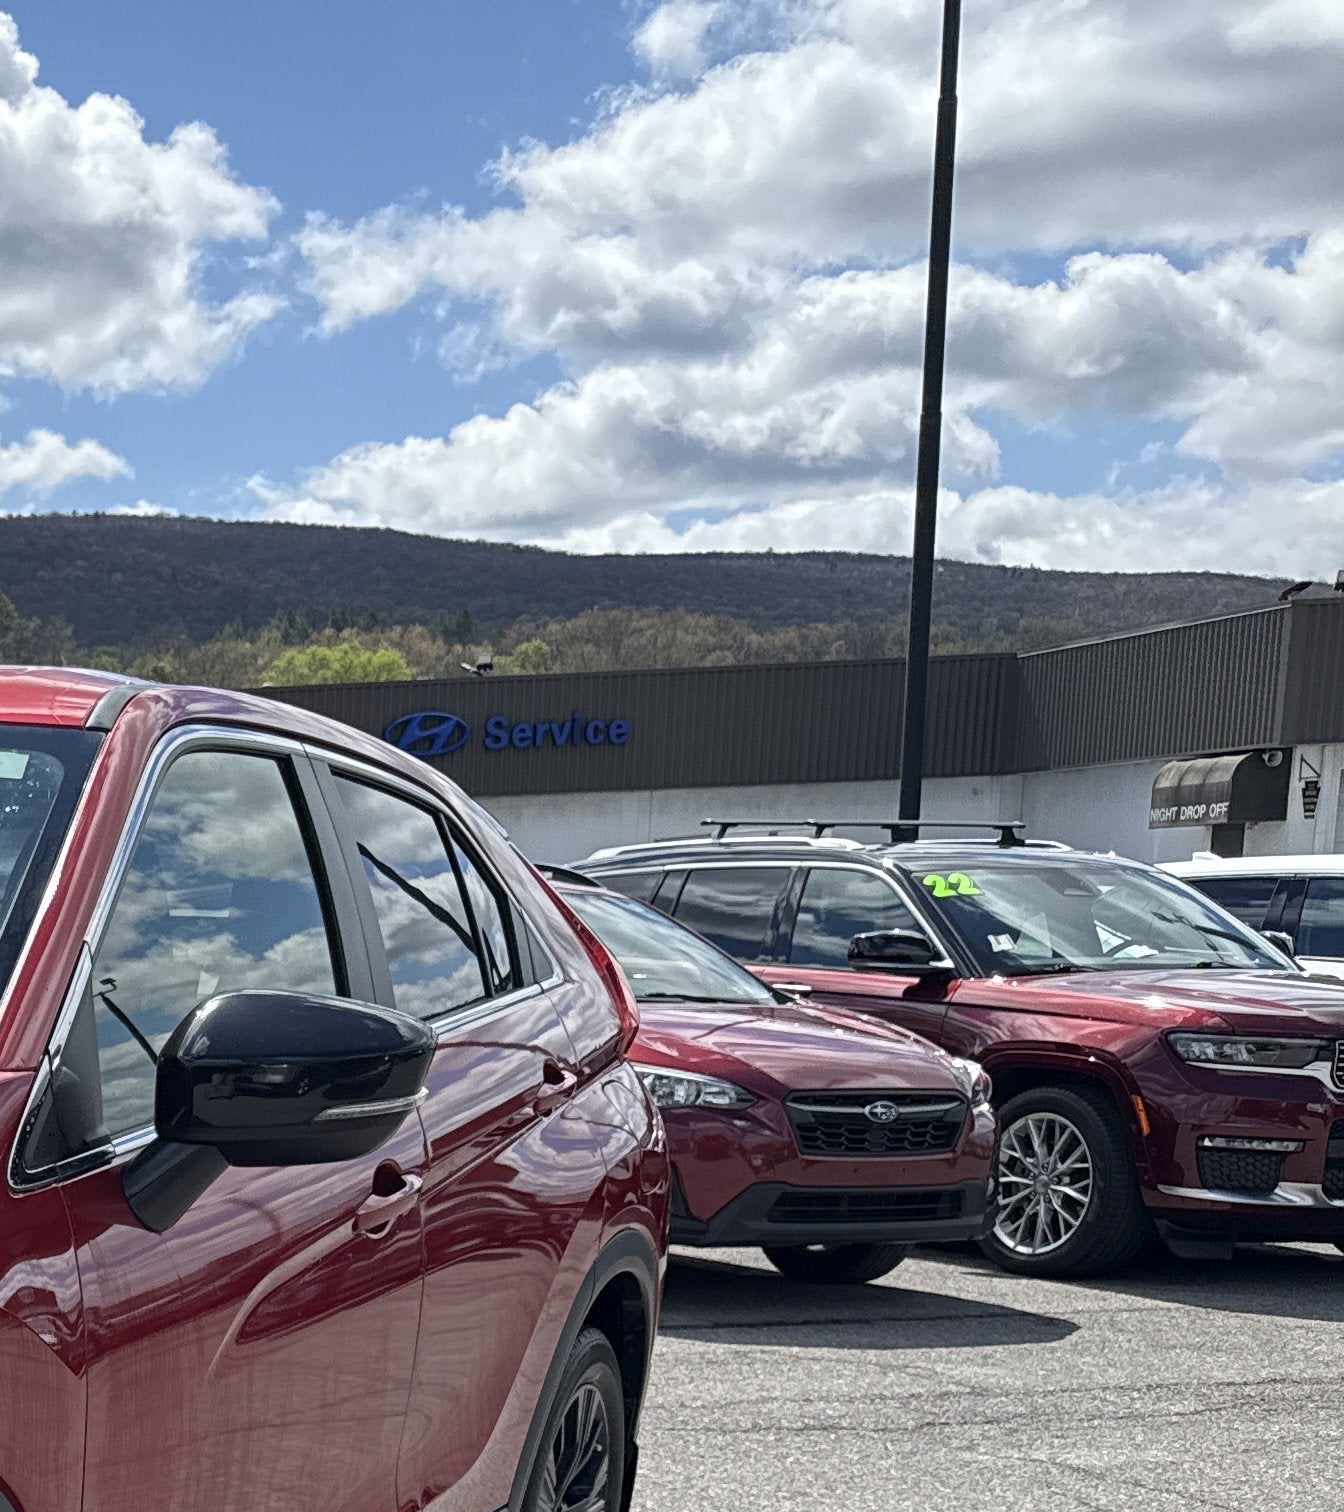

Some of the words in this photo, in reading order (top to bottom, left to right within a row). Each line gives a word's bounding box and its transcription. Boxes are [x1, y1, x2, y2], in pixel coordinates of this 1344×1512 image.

[484, 709, 631, 750] Service
[1150, 806, 1178, 822] NIGHT
[1180, 804, 1207, 821] DROP
[1209, 801, 1230, 818] OFF
[922, 872, 984, 898] 22
